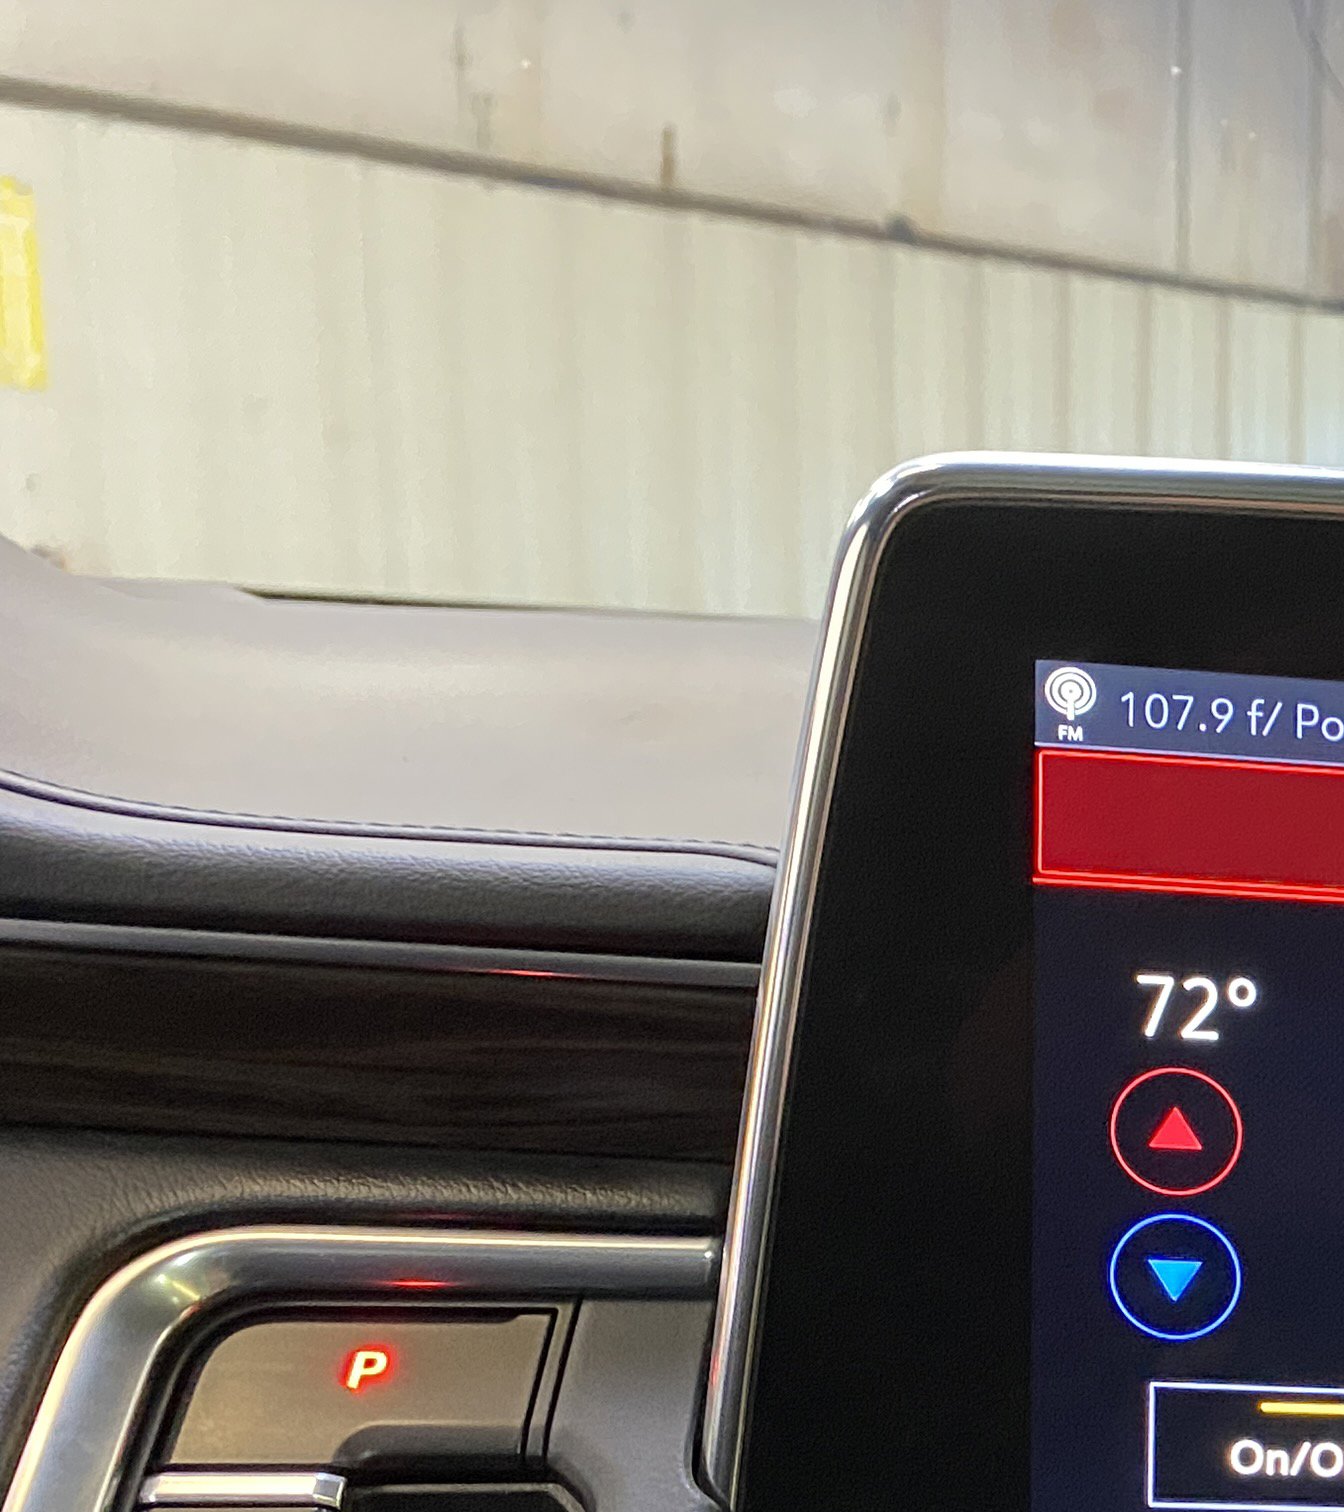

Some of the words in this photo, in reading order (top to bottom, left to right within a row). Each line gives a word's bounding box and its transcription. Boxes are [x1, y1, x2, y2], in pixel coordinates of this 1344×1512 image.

[1056, 722, 1084, 743] FM
[1119, 691, 1237, 736] 107.9
[1246, 698, 1284, 739] f/
[1135, 972, 1258, 1043] 72°
[344, 1349, 389, 1390] P
